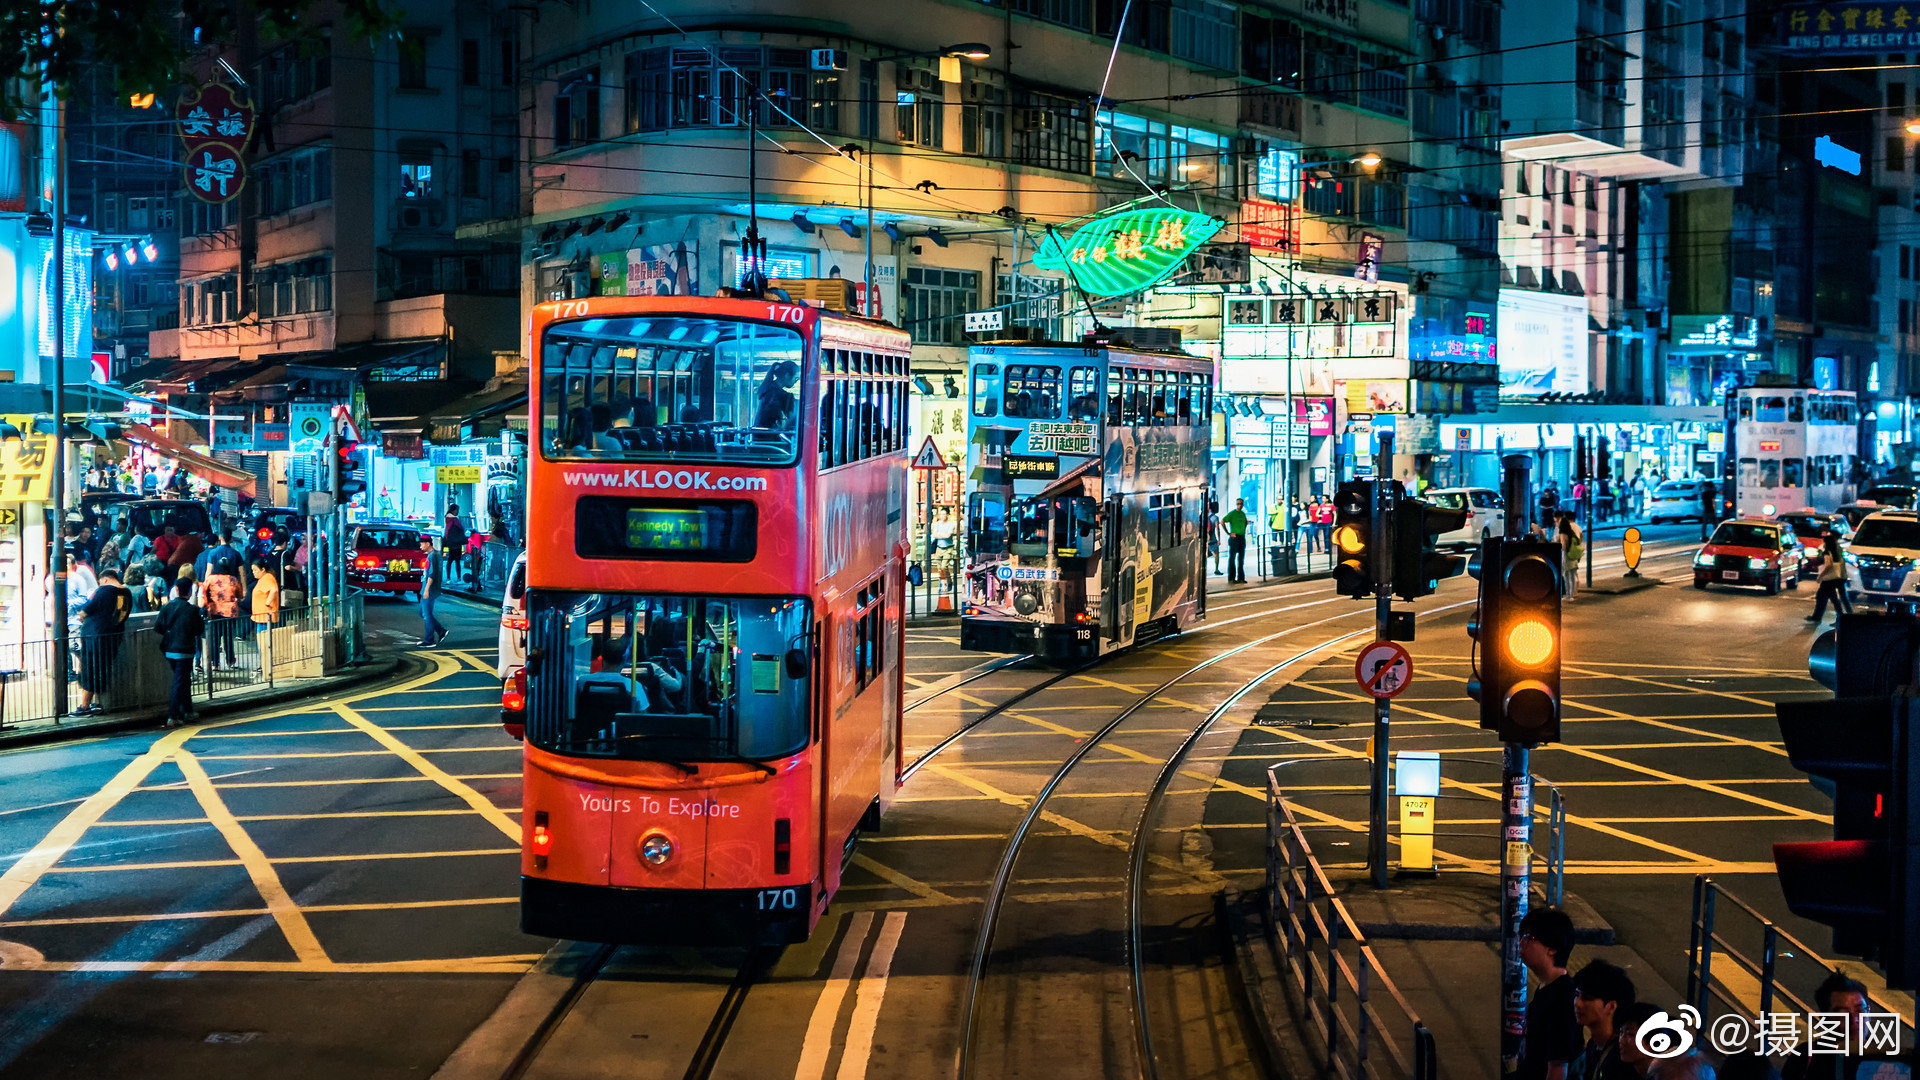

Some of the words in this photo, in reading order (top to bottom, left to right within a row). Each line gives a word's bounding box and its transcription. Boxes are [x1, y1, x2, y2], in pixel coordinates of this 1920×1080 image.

[1789, 36, 1820, 48] WING
[1823, 35, 1840, 47] ON
[1842, 33, 1903, 47] JEWELRY
[194, 151, 237, 196] 押
[553, 301, 589, 319] 170
[766, 305, 804, 324] 170
[982, 347, 995, 355] 118
[1082, 348, 1099, 357] 118
[433, 448, 447, 463] 補
[469, 448, 483, 462] 鞋
[563, 470, 767, 490] www.KLOOK.com
[628, 519, 674, 533] Kennedy
[678, 519, 706, 532] Town
[1076, 630, 1091, 639] 118
[579, 793, 631, 813] Yours
[639, 797, 660, 814] To
[669, 798, 740, 819] Explore
[757, 889, 796, 910] 170
